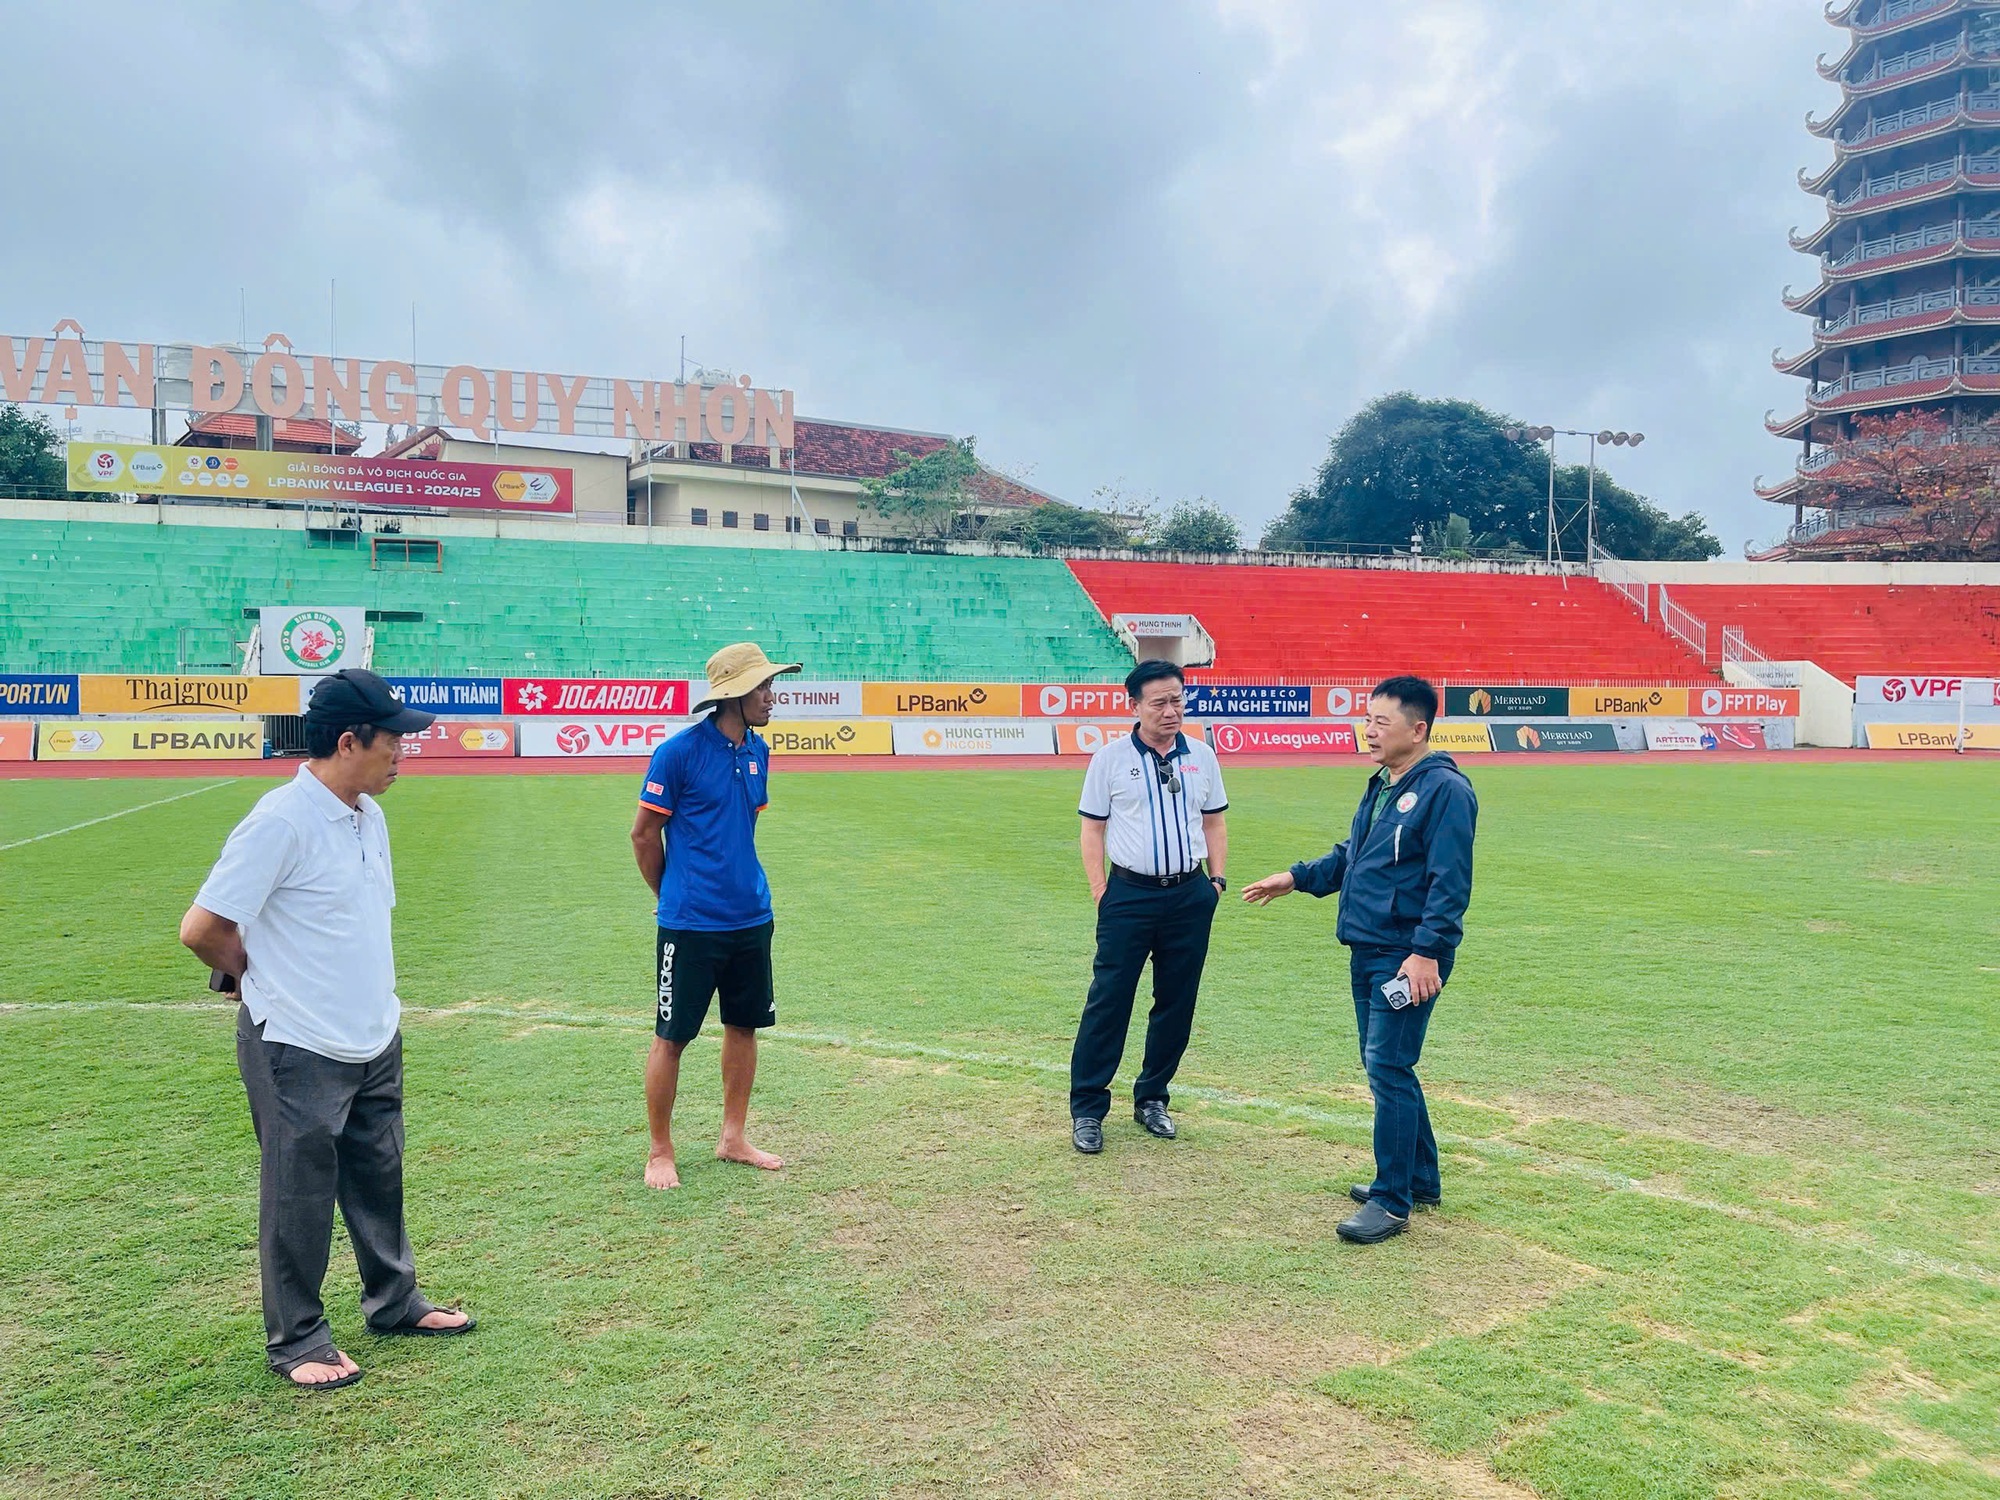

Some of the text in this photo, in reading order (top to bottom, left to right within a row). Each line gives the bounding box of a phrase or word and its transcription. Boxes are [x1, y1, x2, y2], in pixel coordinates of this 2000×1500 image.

[442, 365, 589, 440] QUY
[614, 374, 795, 448] NHƠN
[132, 463, 157, 471] LPBank
[313, 464, 345, 474] BÓNG
[348, 466, 364, 476] ĐÁ
[386, 469, 412, 479] ĐỊCH
[414, 469, 446, 480] QUỐC
[448, 472, 467, 481] GIA
[268, 477, 330, 490] LPBANK
[333, 480, 404, 493] V.LEAGUE
[406, 484, 414, 494] 1
[424, 485, 481, 497] 2024/25
[1138, 620, 1160, 628] HUNG
[410, 682, 449, 704] XUÂN
[452, 682, 499, 704] THÀNH
[1221, 689, 1297, 698] SAVABECO
[1910, 678, 1962, 697] VPF
[553, 685, 676, 710] JOGARBOLA
[792, 692, 840, 705] THINH
[897, 694, 969, 712] LPBank
[1071, 691, 1130, 710] FPT Pl
[1198, 700, 1309, 712] BIA NGHE TINH
[1595, 697, 1648, 713] LPBank
[1725, 694, 1788, 716] FPT Play
[133, 732, 257, 750] LPBANK
[437, 726, 449, 740] 1
[594, 724, 665, 746] VPF
[769, 733, 836, 750] PBank
[945, 728, 1025, 738] HUNG THINH
[1248, 731, 1352, 749] V.League.VPF
[1450, 734, 1486, 743] LPBANK
[1898, 732, 1957, 746] LPBank
[946, 740, 992, 749] INCONS
[659, 943, 675, 1021] adidas
